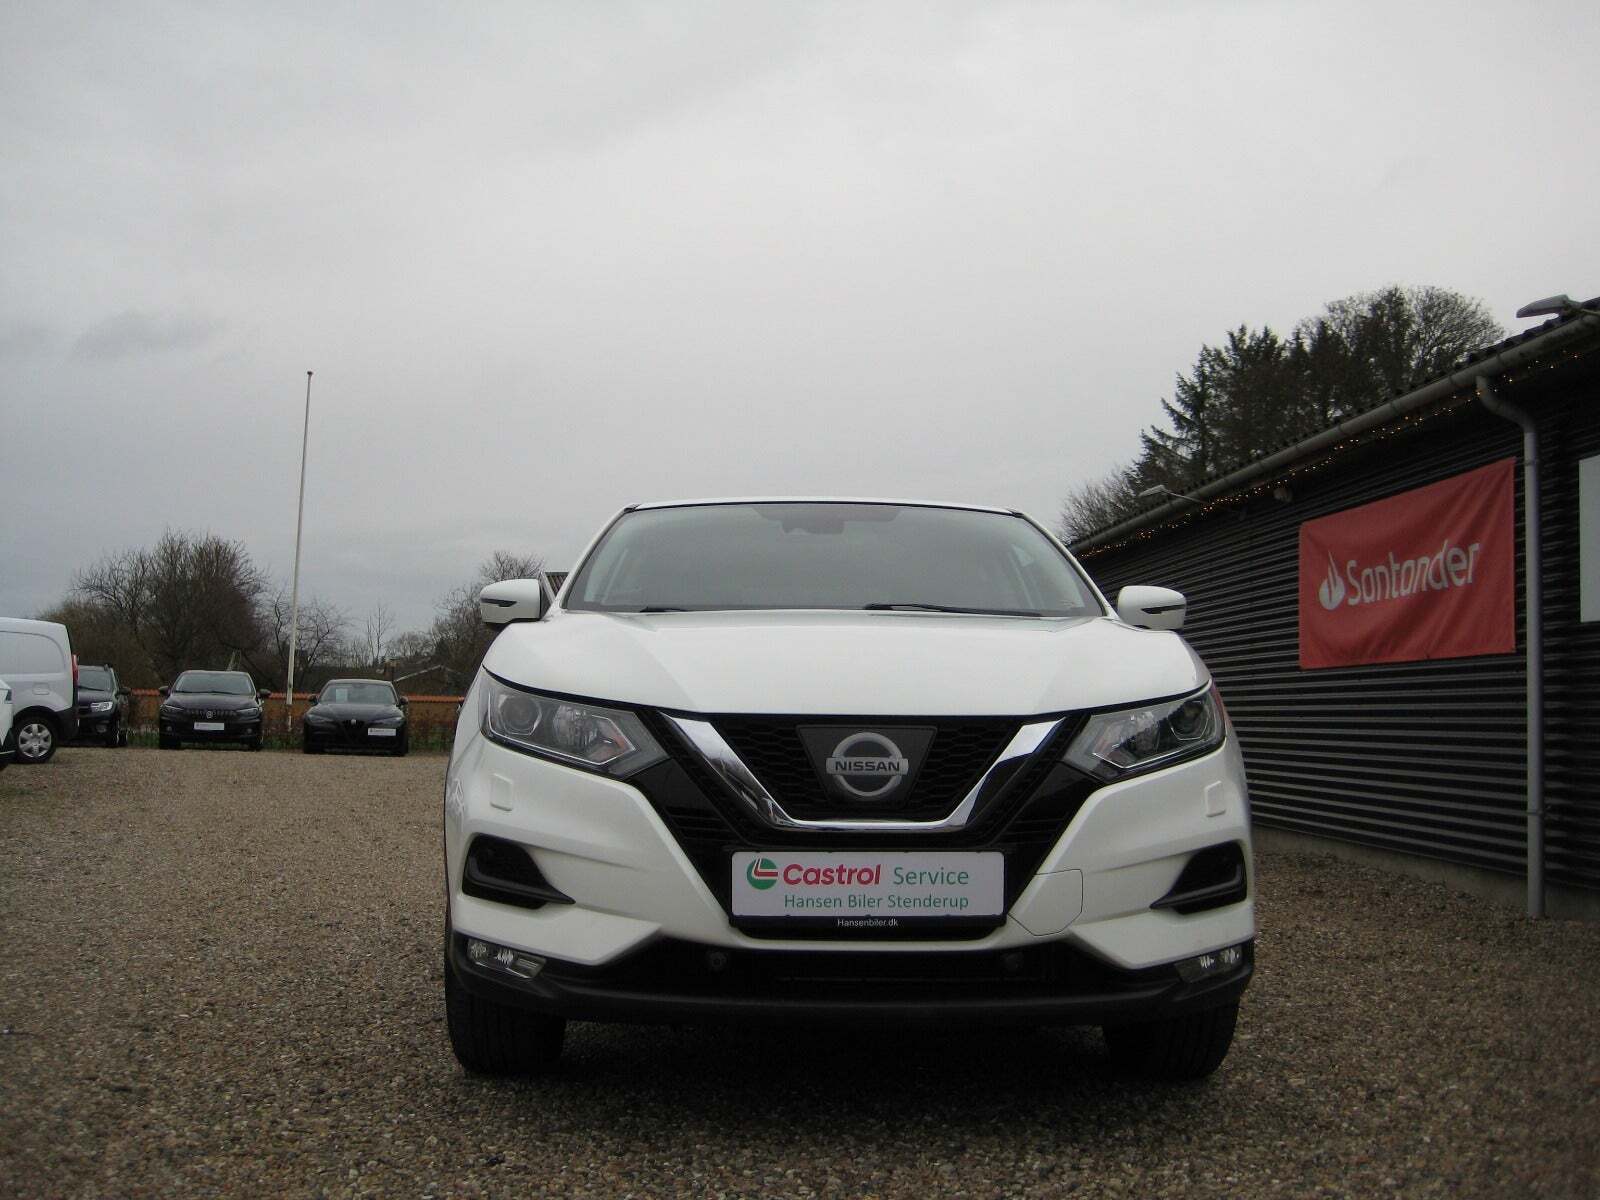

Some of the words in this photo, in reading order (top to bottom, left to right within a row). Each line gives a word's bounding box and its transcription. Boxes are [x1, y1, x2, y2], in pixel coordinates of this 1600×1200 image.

[1347, 539, 1480, 606] Santander
[835, 761, 900, 772] NISSAN
[783, 863, 882, 886] Castrol
[893, 866, 969, 886] Service
[784, 894, 842, 909] Hansen
[848, 894, 883, 909] Biler
[887, 894, 969, 911] Stenderup
[837, 918, 899, 927] Hansenbiler.dk
